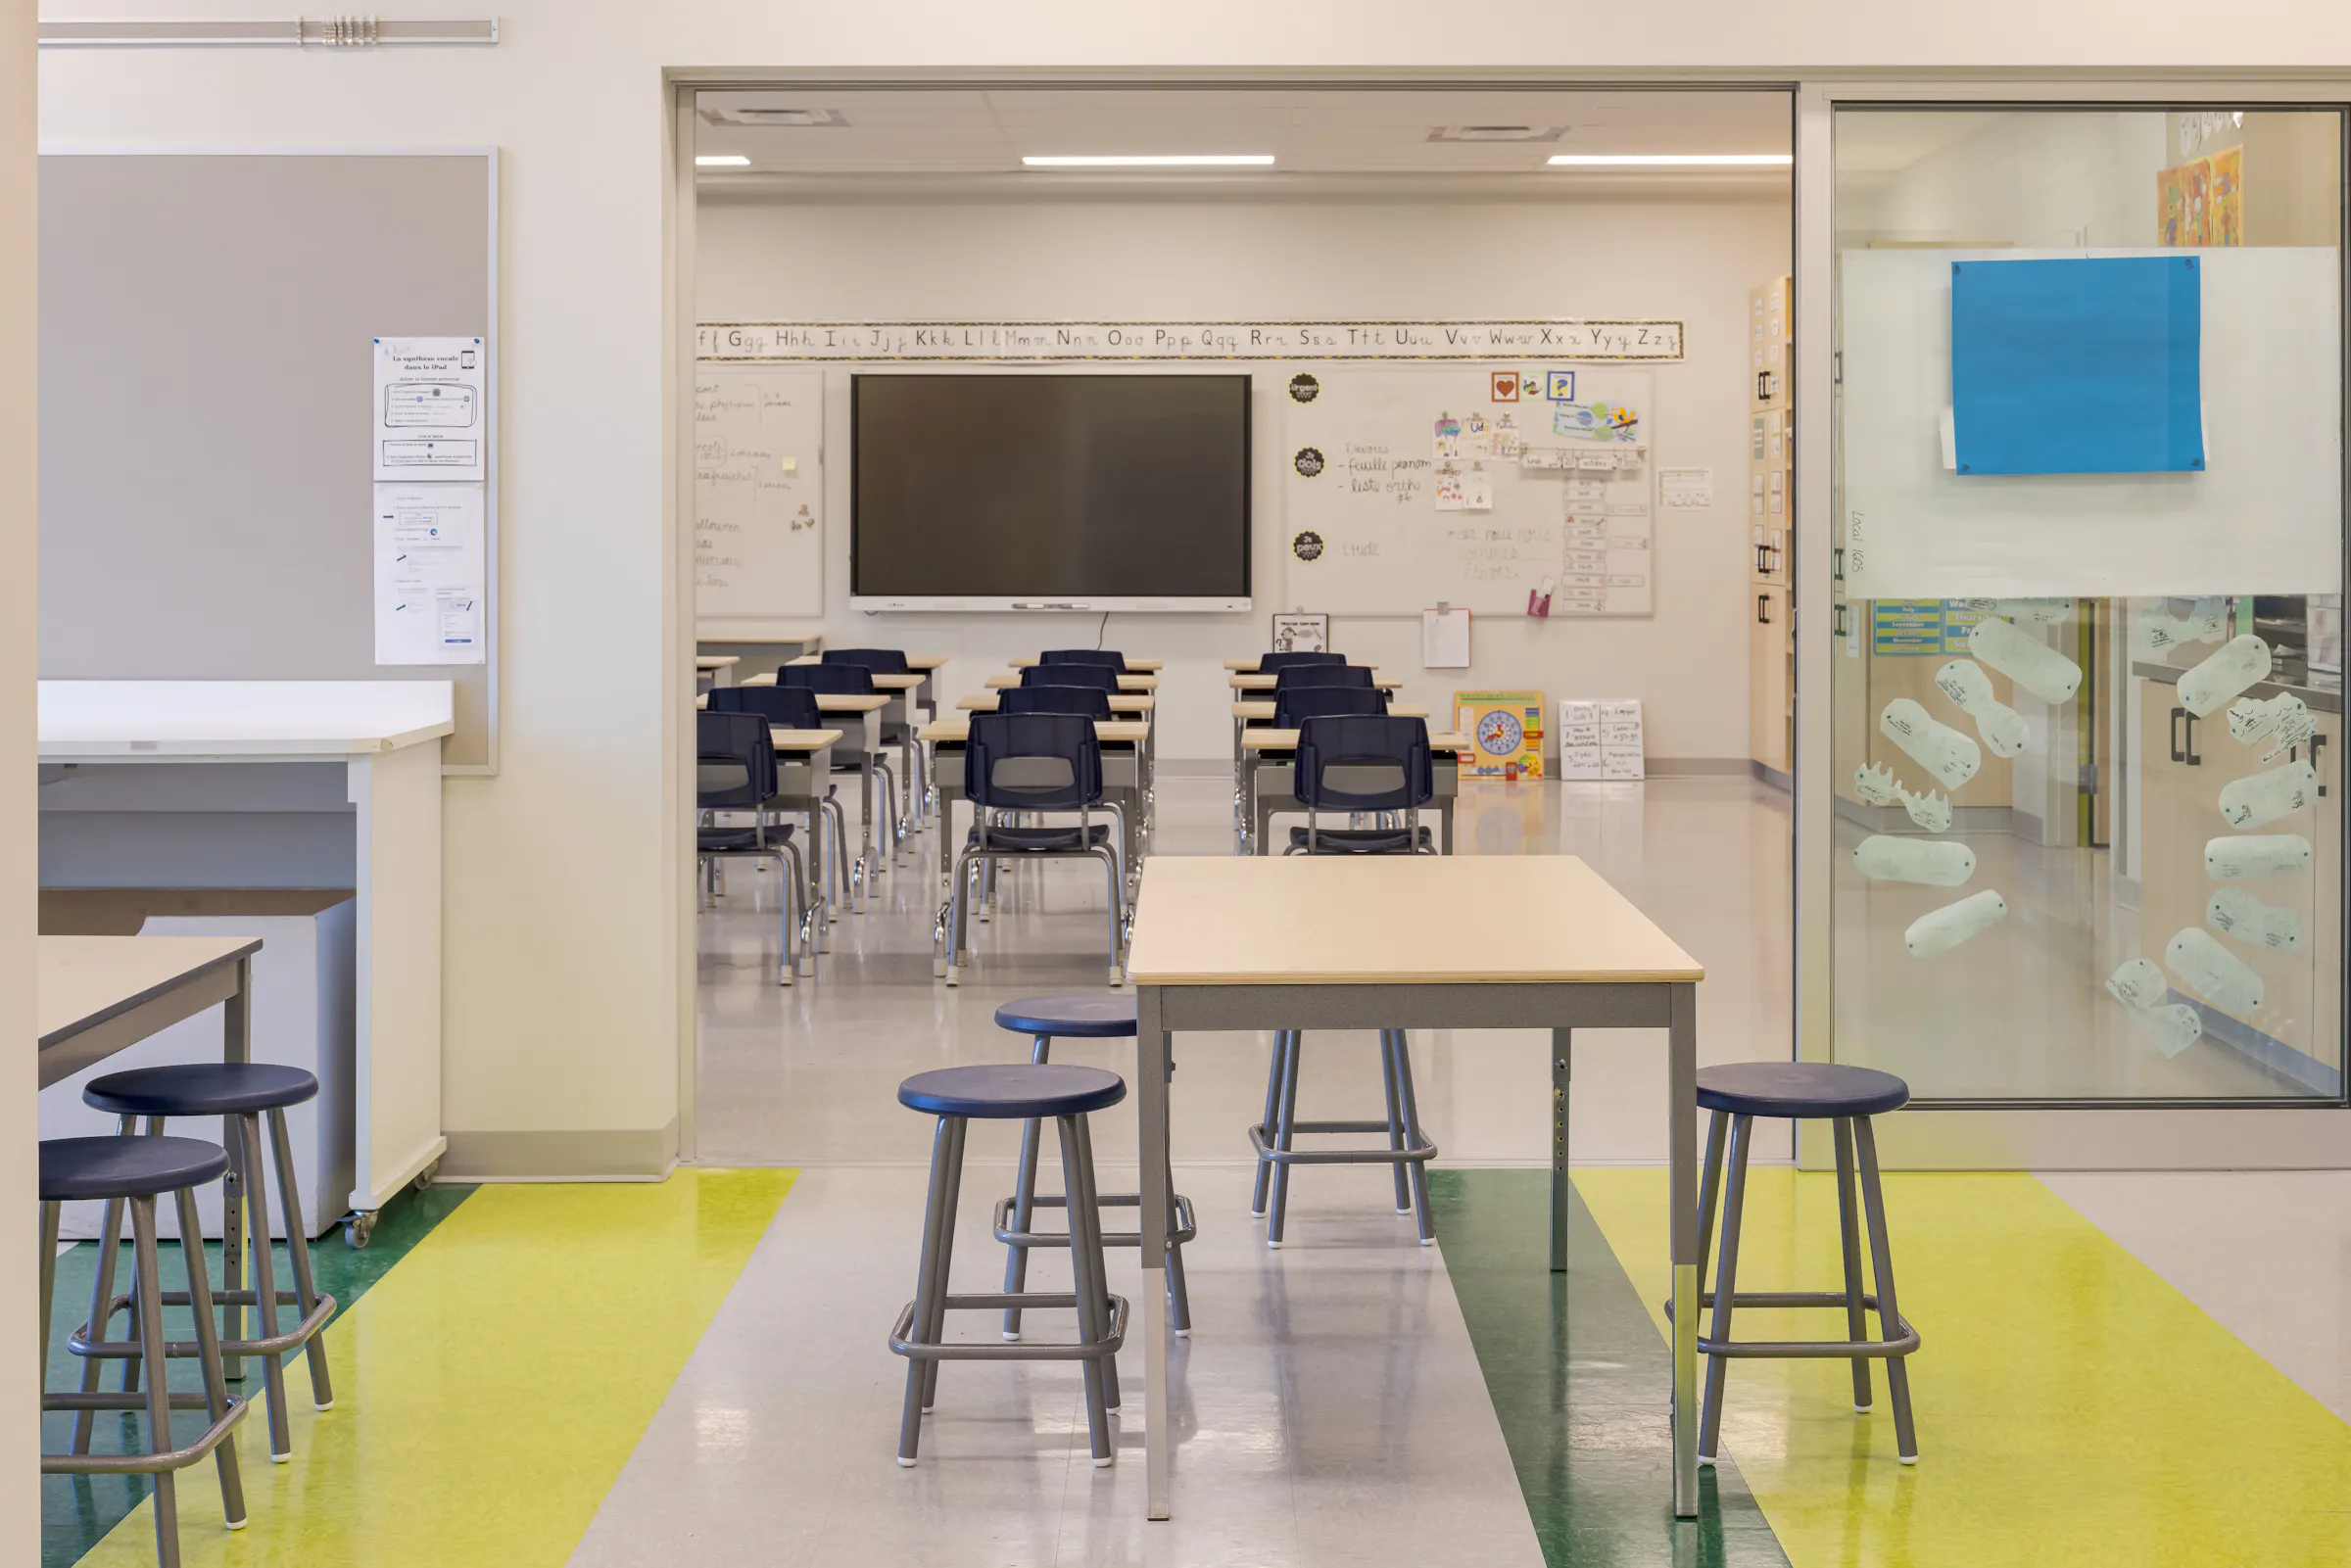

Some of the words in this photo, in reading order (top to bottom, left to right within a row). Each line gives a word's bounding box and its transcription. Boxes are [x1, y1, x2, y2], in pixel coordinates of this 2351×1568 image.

[1297, 458, 1321, 470] dois
[1852, 510, 1864, 542] Local
[1296, 543, 1322, 553] peux
